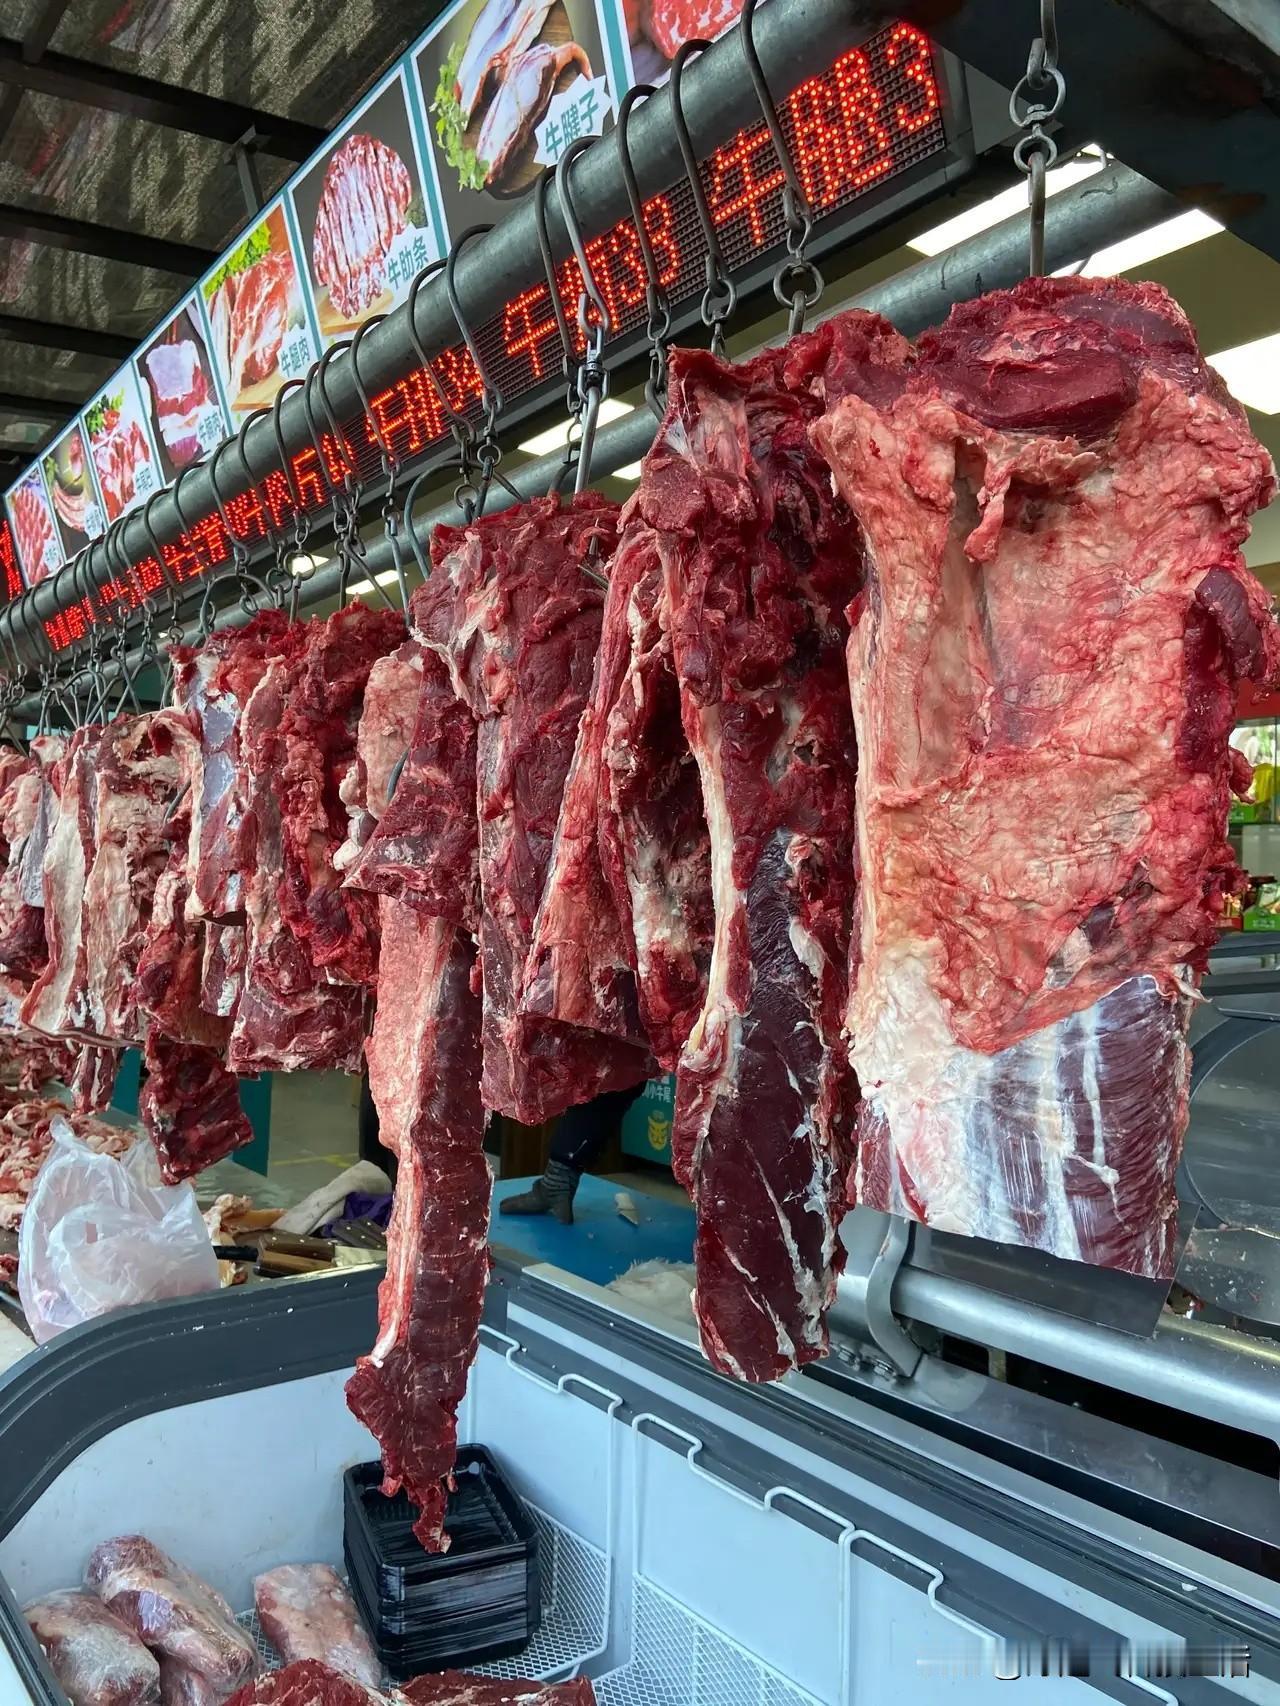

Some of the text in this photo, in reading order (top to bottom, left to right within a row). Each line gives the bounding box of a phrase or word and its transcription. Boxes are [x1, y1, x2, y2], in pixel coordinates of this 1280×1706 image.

[545, 88, 599, 161] 牛腱子
[387, 235, 429, 290] 牛肋条
